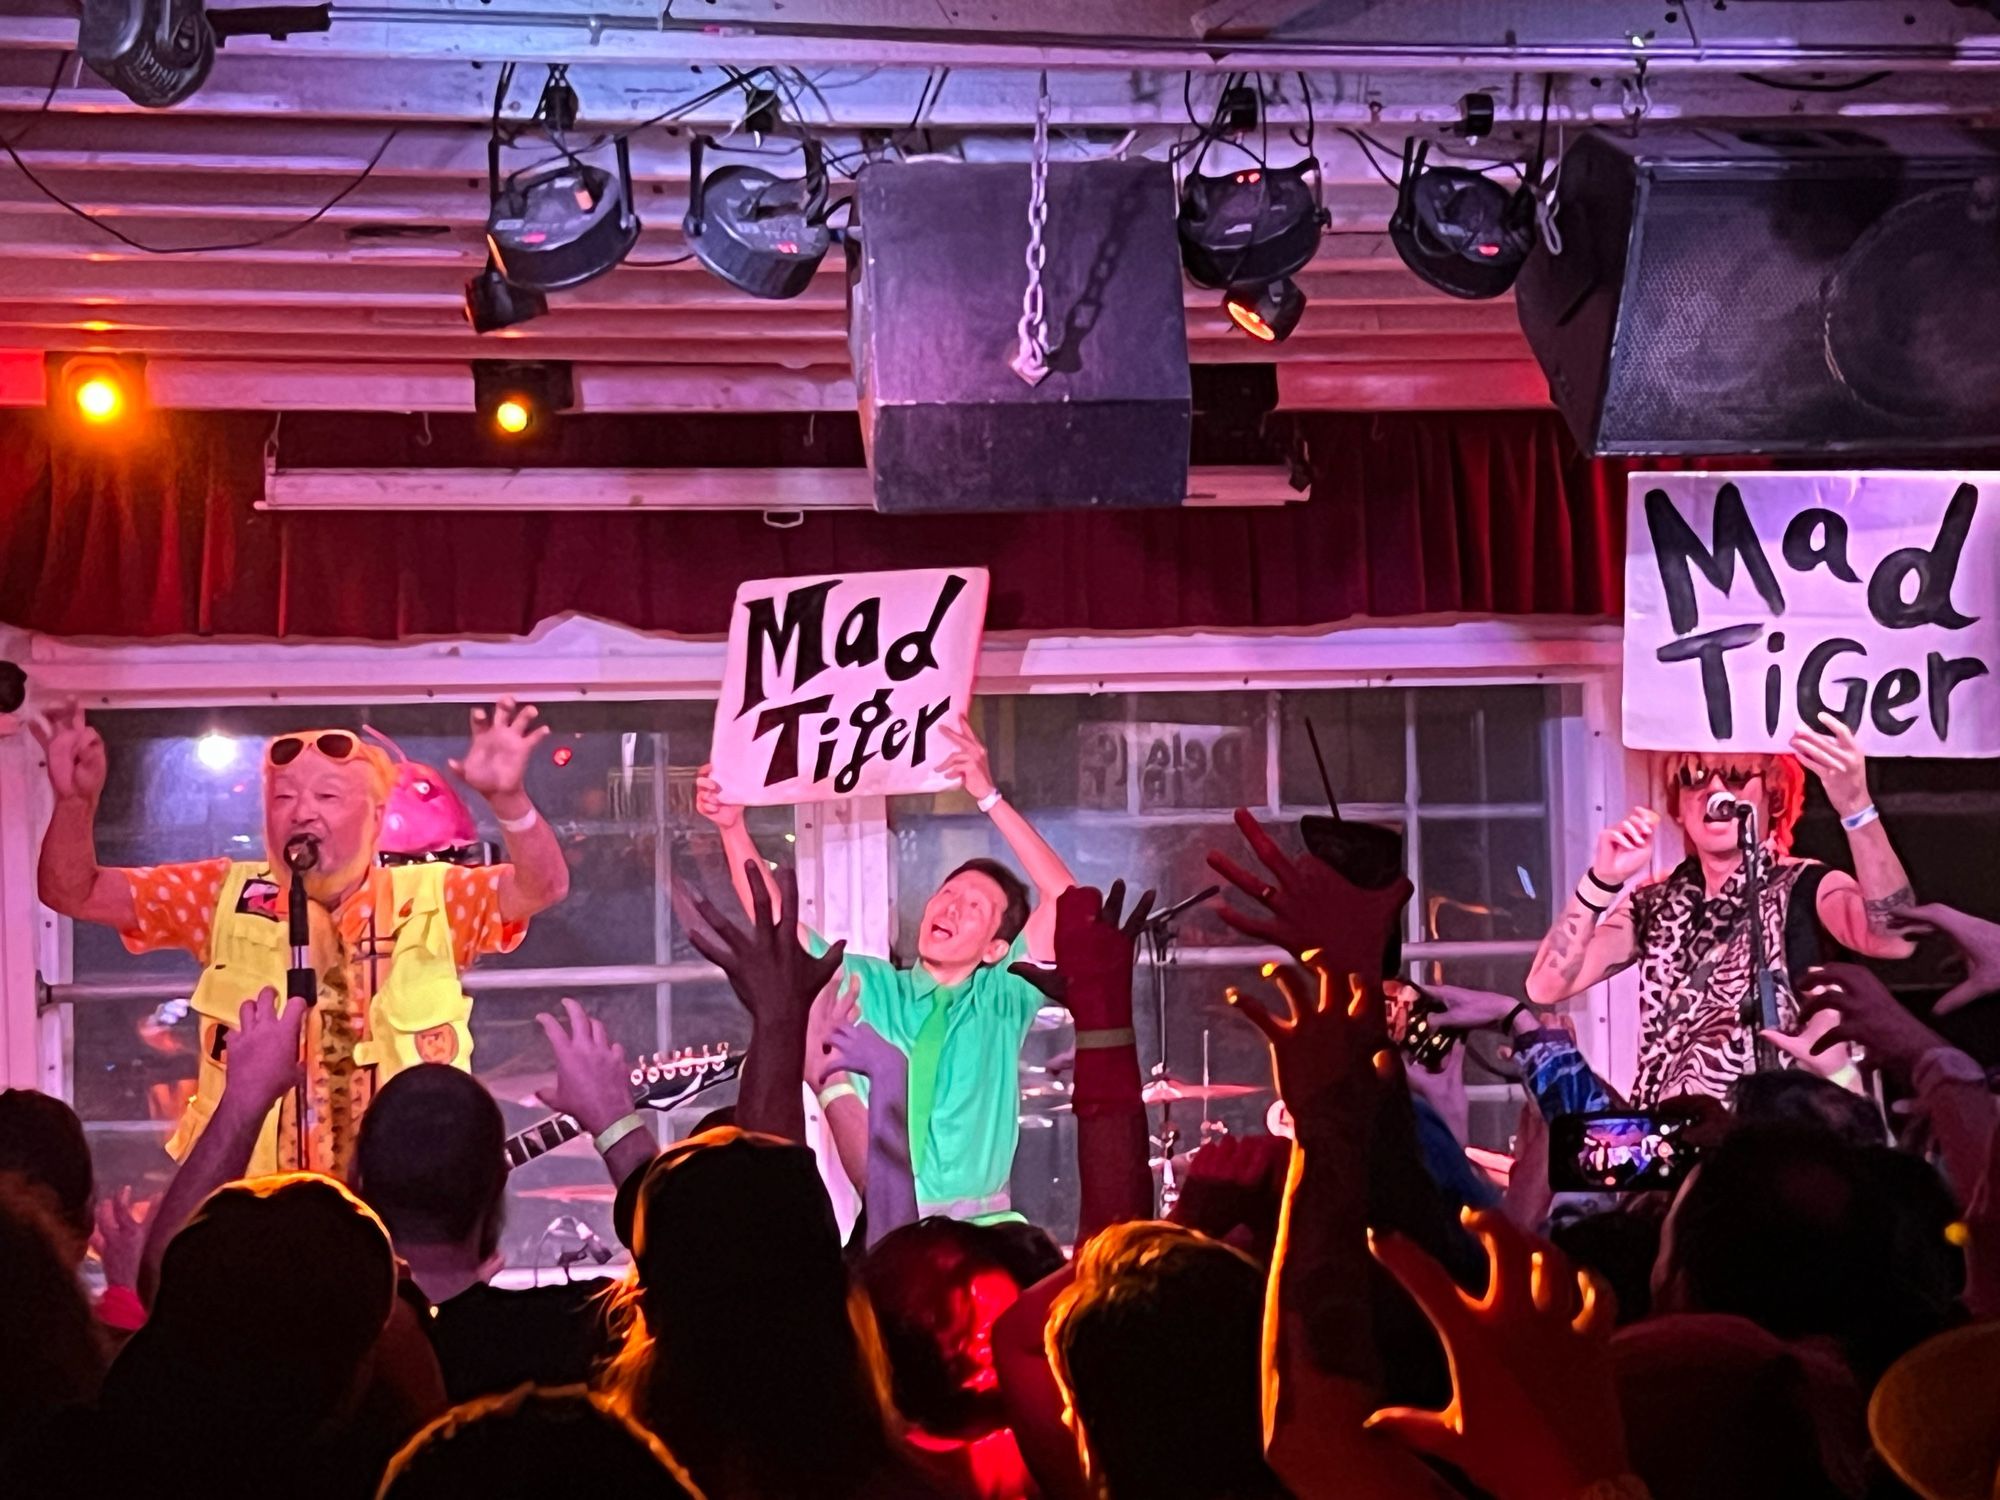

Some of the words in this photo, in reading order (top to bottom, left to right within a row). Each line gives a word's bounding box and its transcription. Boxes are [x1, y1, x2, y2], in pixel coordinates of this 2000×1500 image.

[1644, 481, 1981, 636] Mad
[733, 574, 968, 722] Mad
[752, 688, 951, 794] Tiger
